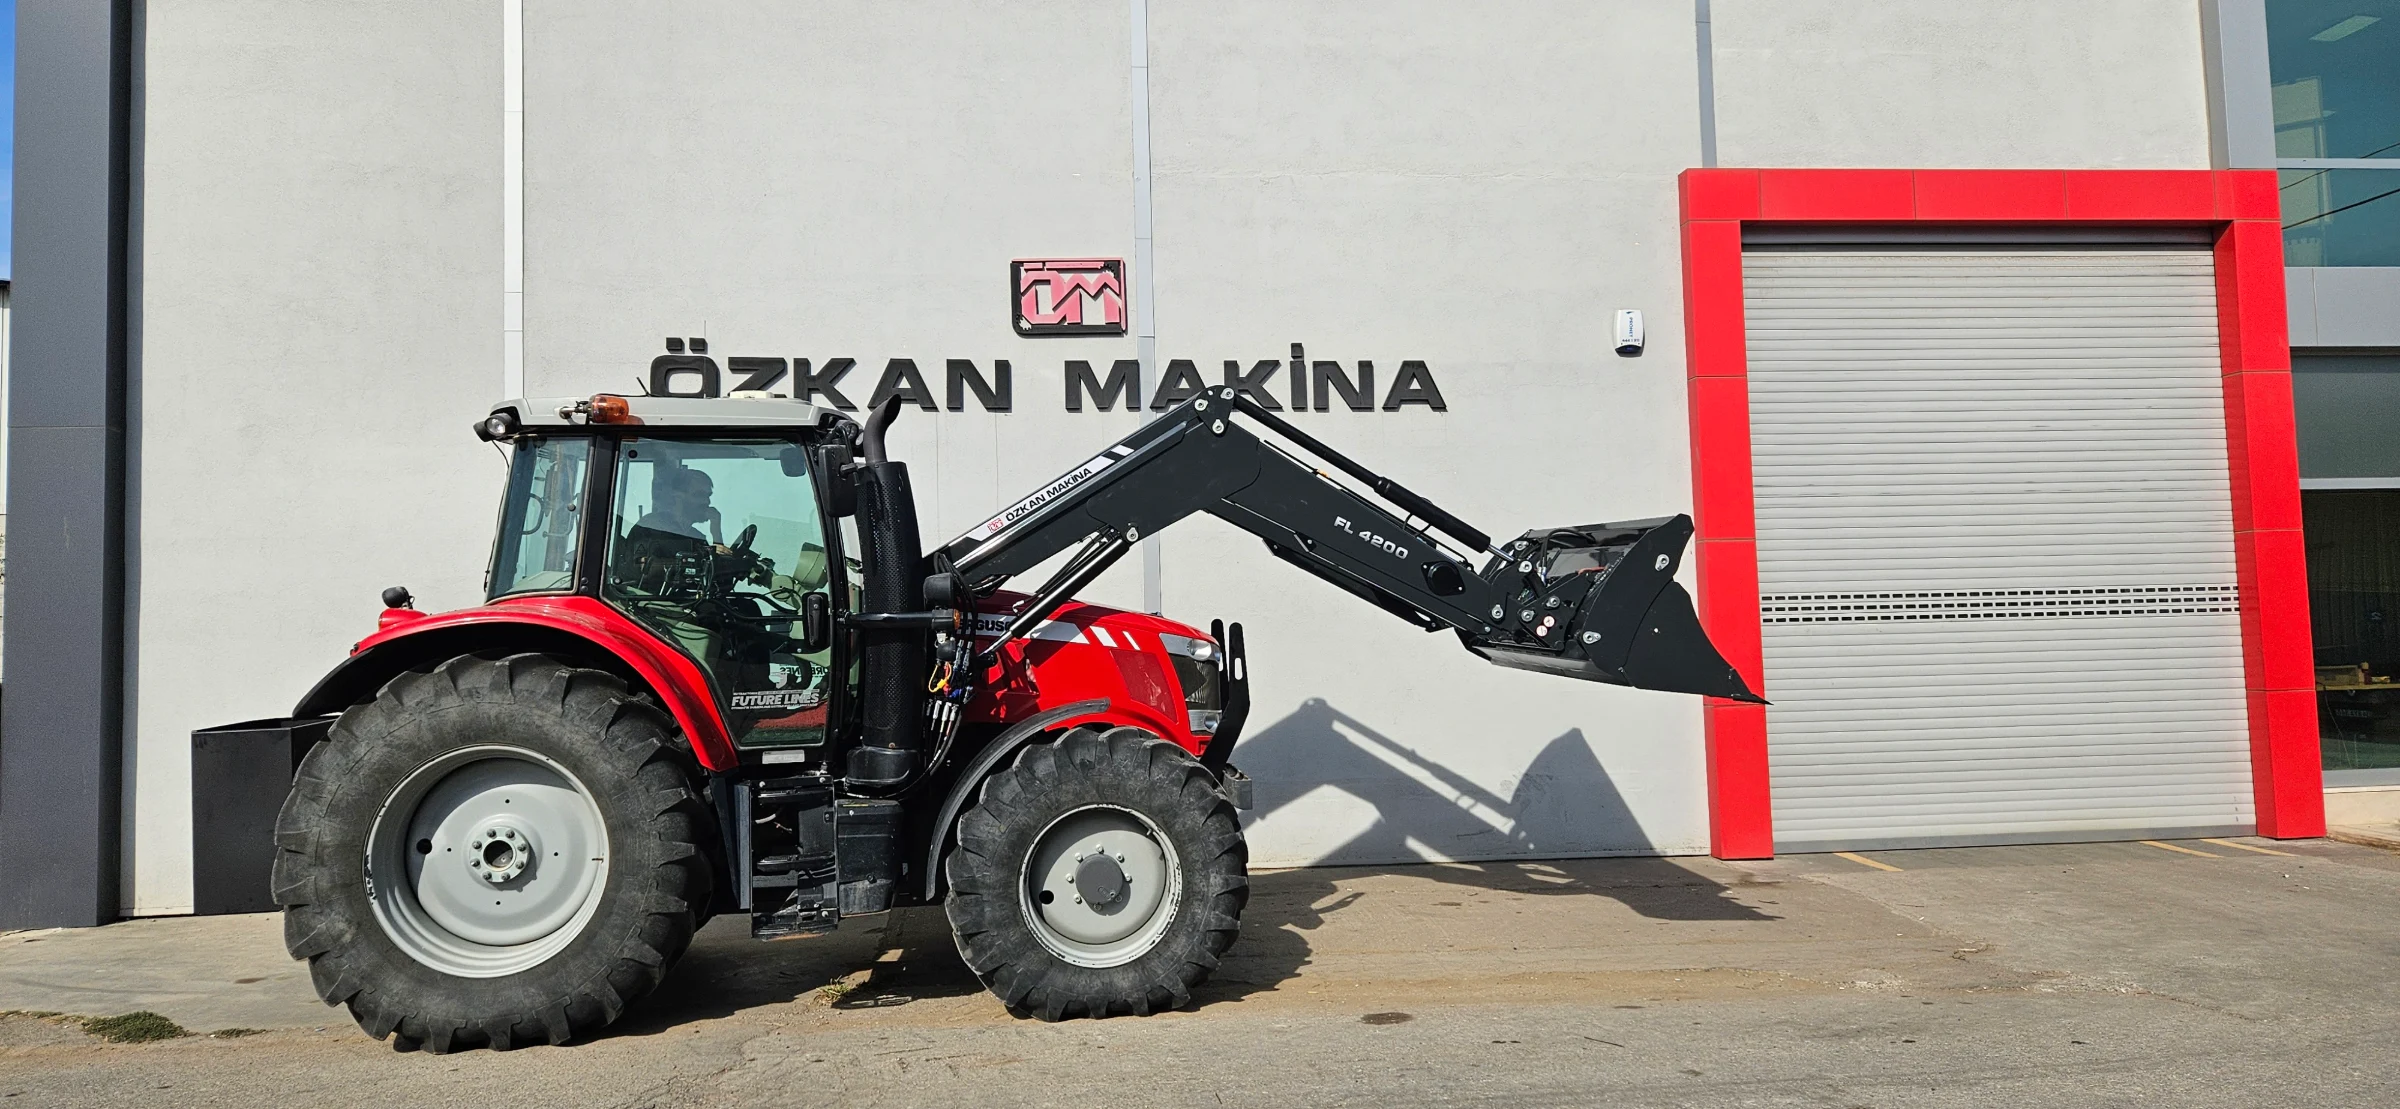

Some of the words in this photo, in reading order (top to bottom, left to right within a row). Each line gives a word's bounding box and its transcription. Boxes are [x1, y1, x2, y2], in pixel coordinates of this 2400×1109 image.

[650, 336, 1012, 413] ÖZKAN
[1064, 342, 1448, 413] MAKİNA
[1005, 494, 1046, 522] ÖZKAN
[1046, 467, 1092, 498] MAKİNA
[1333, 516, 1354, 535] FL
[1358, 530, 1409, 560] 4200
[731, 694, 783, 707] FUTURE
[784, 692, 820, 705] LINES
